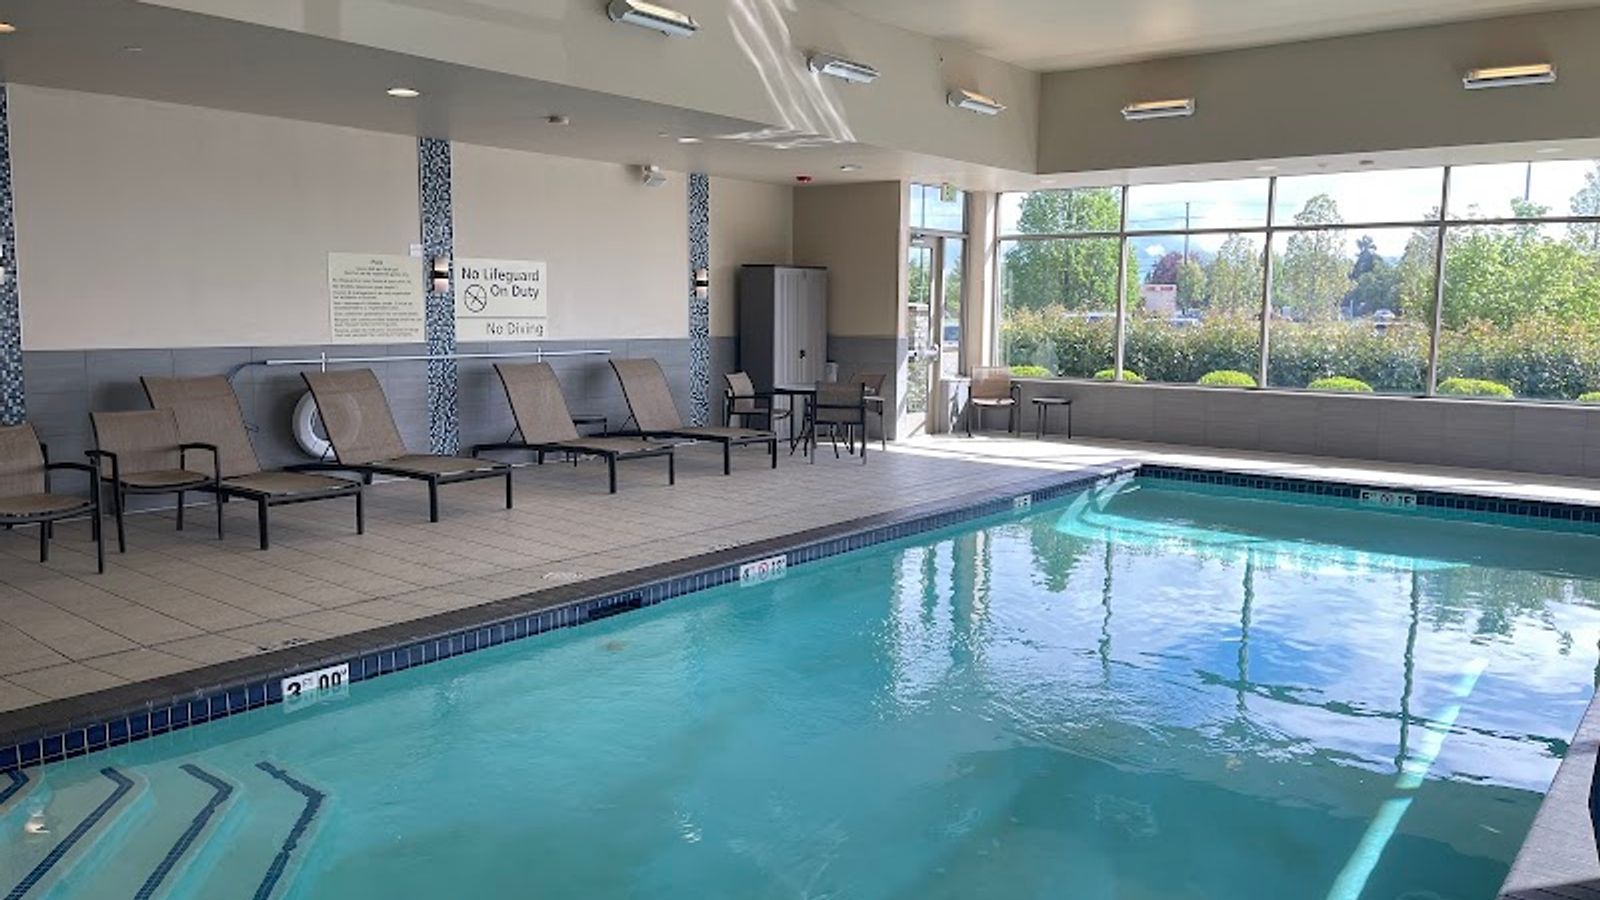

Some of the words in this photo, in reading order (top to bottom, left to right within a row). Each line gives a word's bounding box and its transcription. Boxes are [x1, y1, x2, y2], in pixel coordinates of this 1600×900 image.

[461, 267, 480, 280] No
[484, 267, 539, 284] Lifeguard
[490, 284, 508, 297] On
[512, 284, 539, 300] Duty
[487, 322, 504, 335] No
[508, 322, 544, 337] Diving
